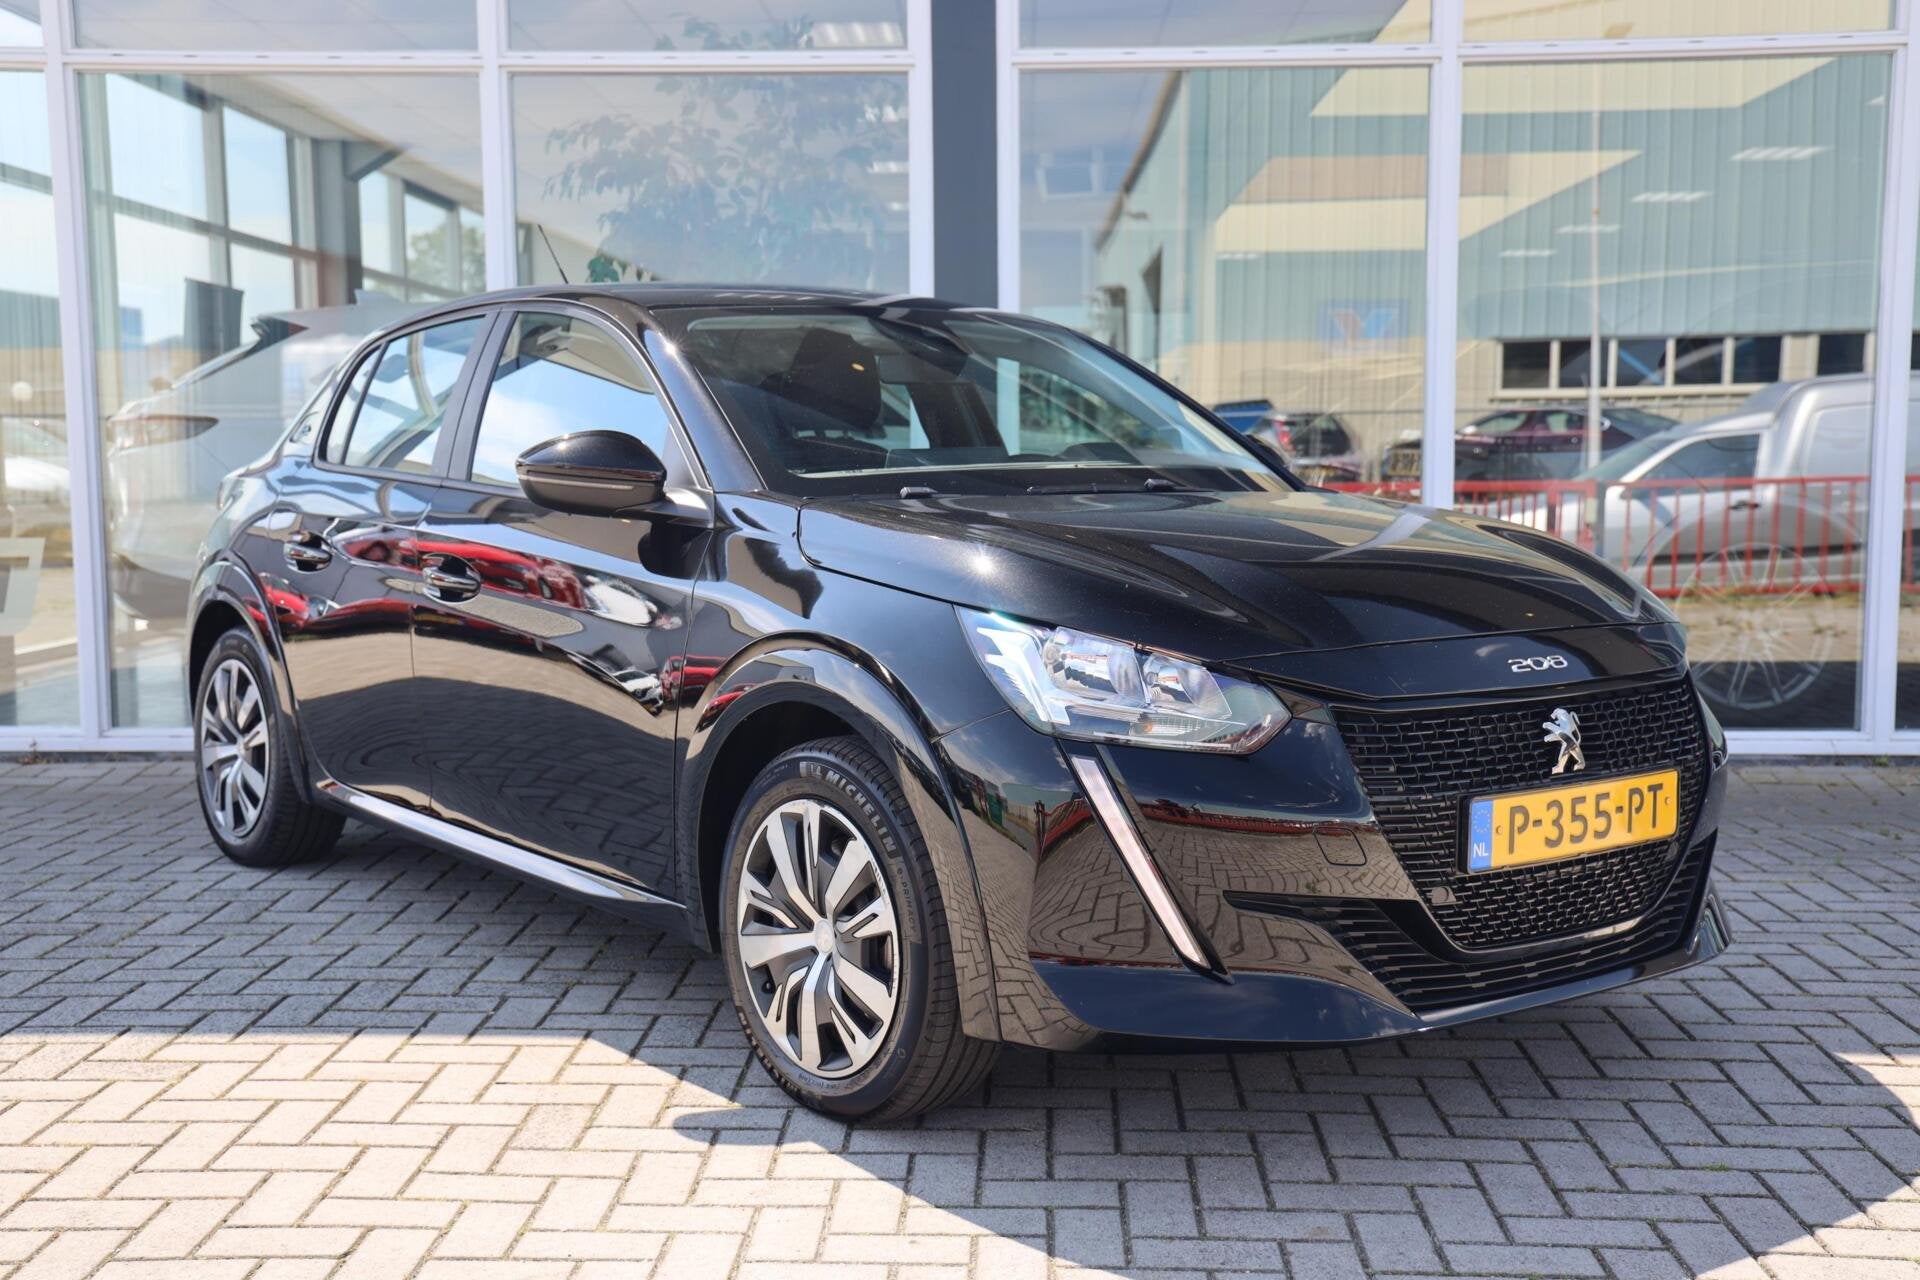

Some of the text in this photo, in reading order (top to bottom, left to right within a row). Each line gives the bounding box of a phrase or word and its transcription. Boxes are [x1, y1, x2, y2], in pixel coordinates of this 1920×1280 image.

[1507, 655, 1569, 673] 208
[825, 769, 897, 853] MICHELIN
[1508, 783, 1664, 855] P-355-PT
[1473, 842, 1489, 857] NL
